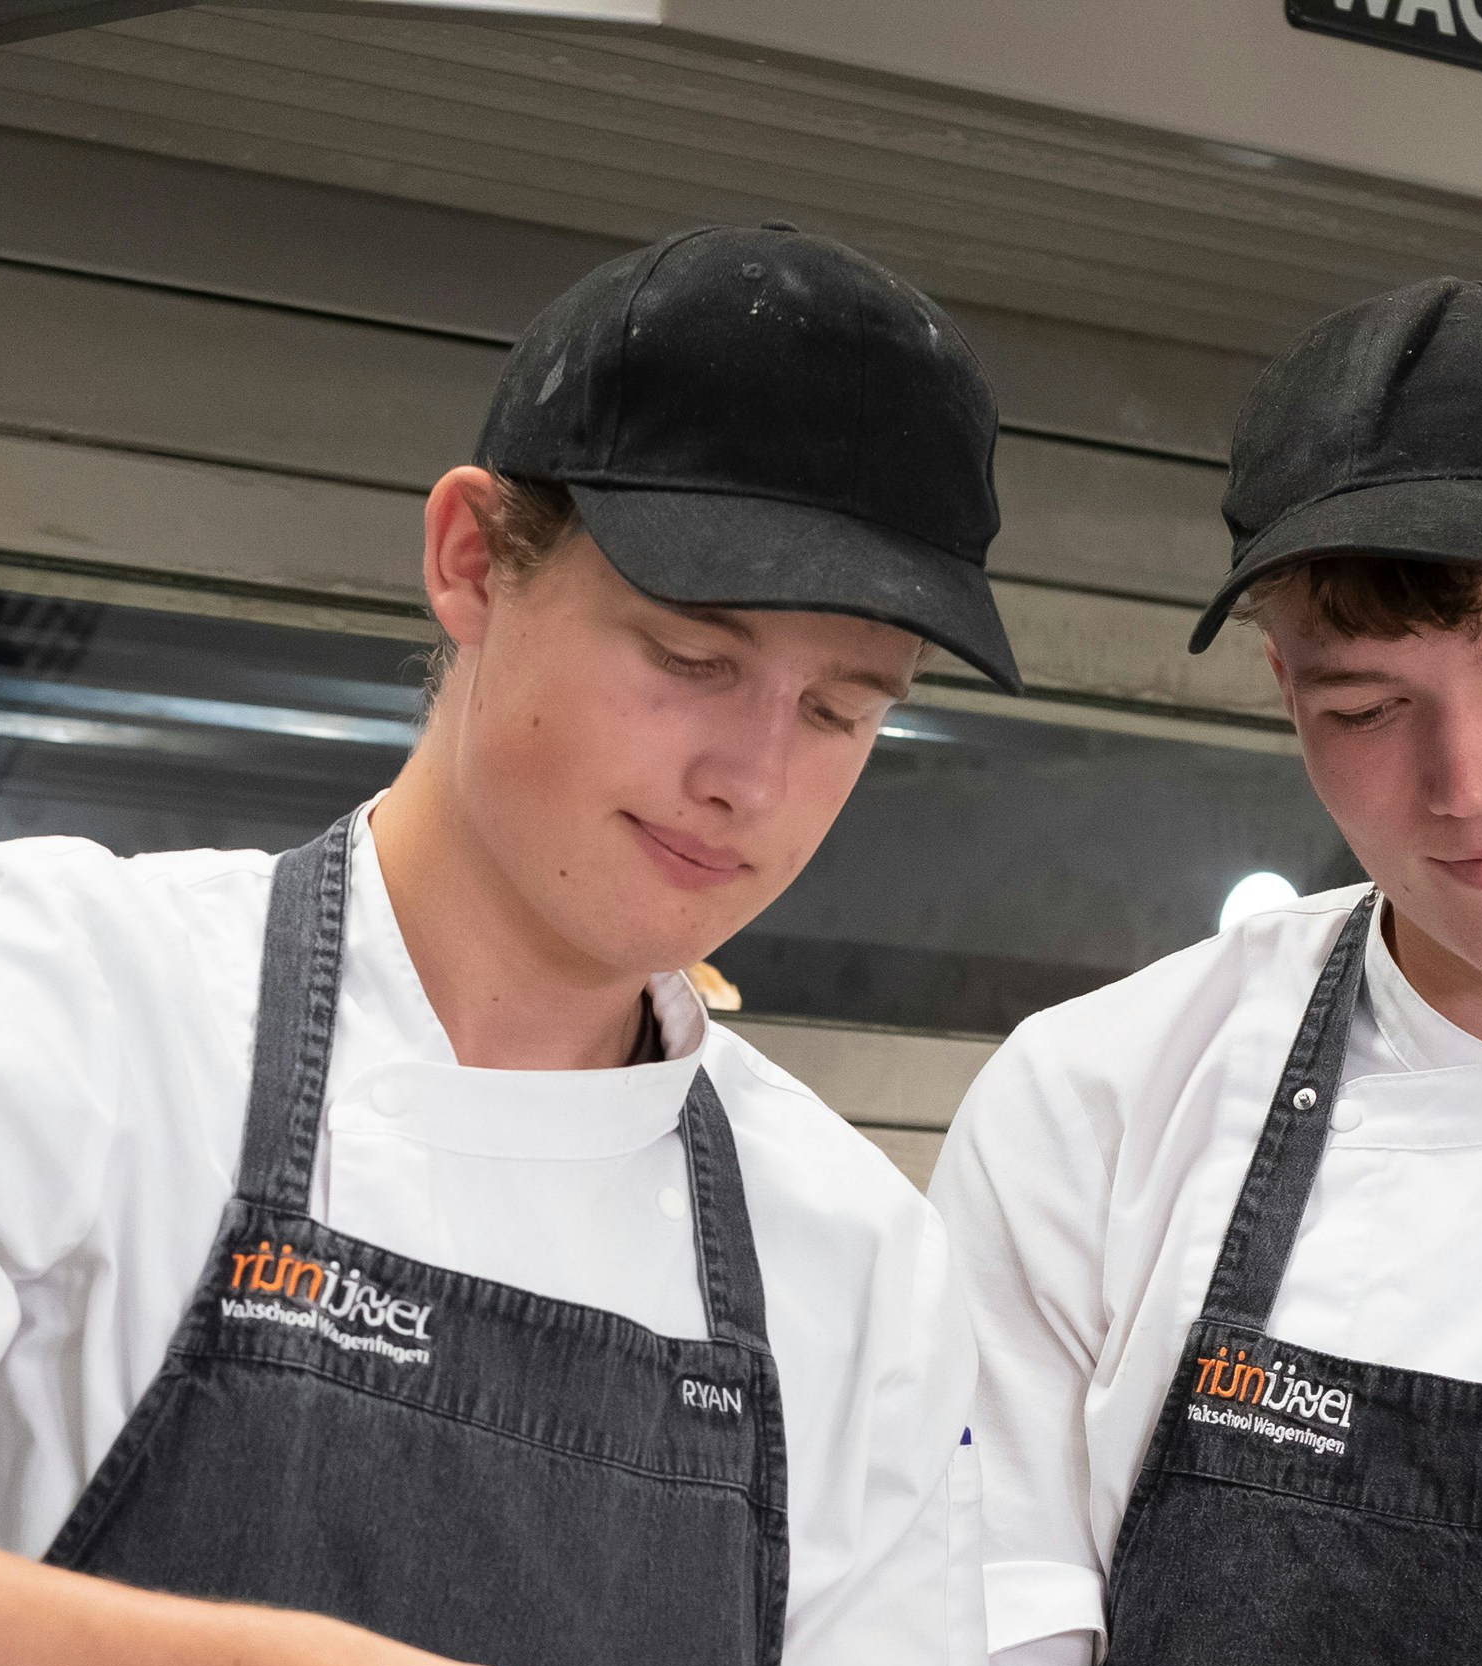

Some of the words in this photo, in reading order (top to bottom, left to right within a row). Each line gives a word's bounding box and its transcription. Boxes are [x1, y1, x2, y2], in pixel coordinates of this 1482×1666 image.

[221, 1297, 318, 1329] Vakschool
[318, 1316, 430, 1365] Wageningen
[682, 1379, 742, 1414] RYAN
[1253, 1416, 1345, 1455] Wageningen
